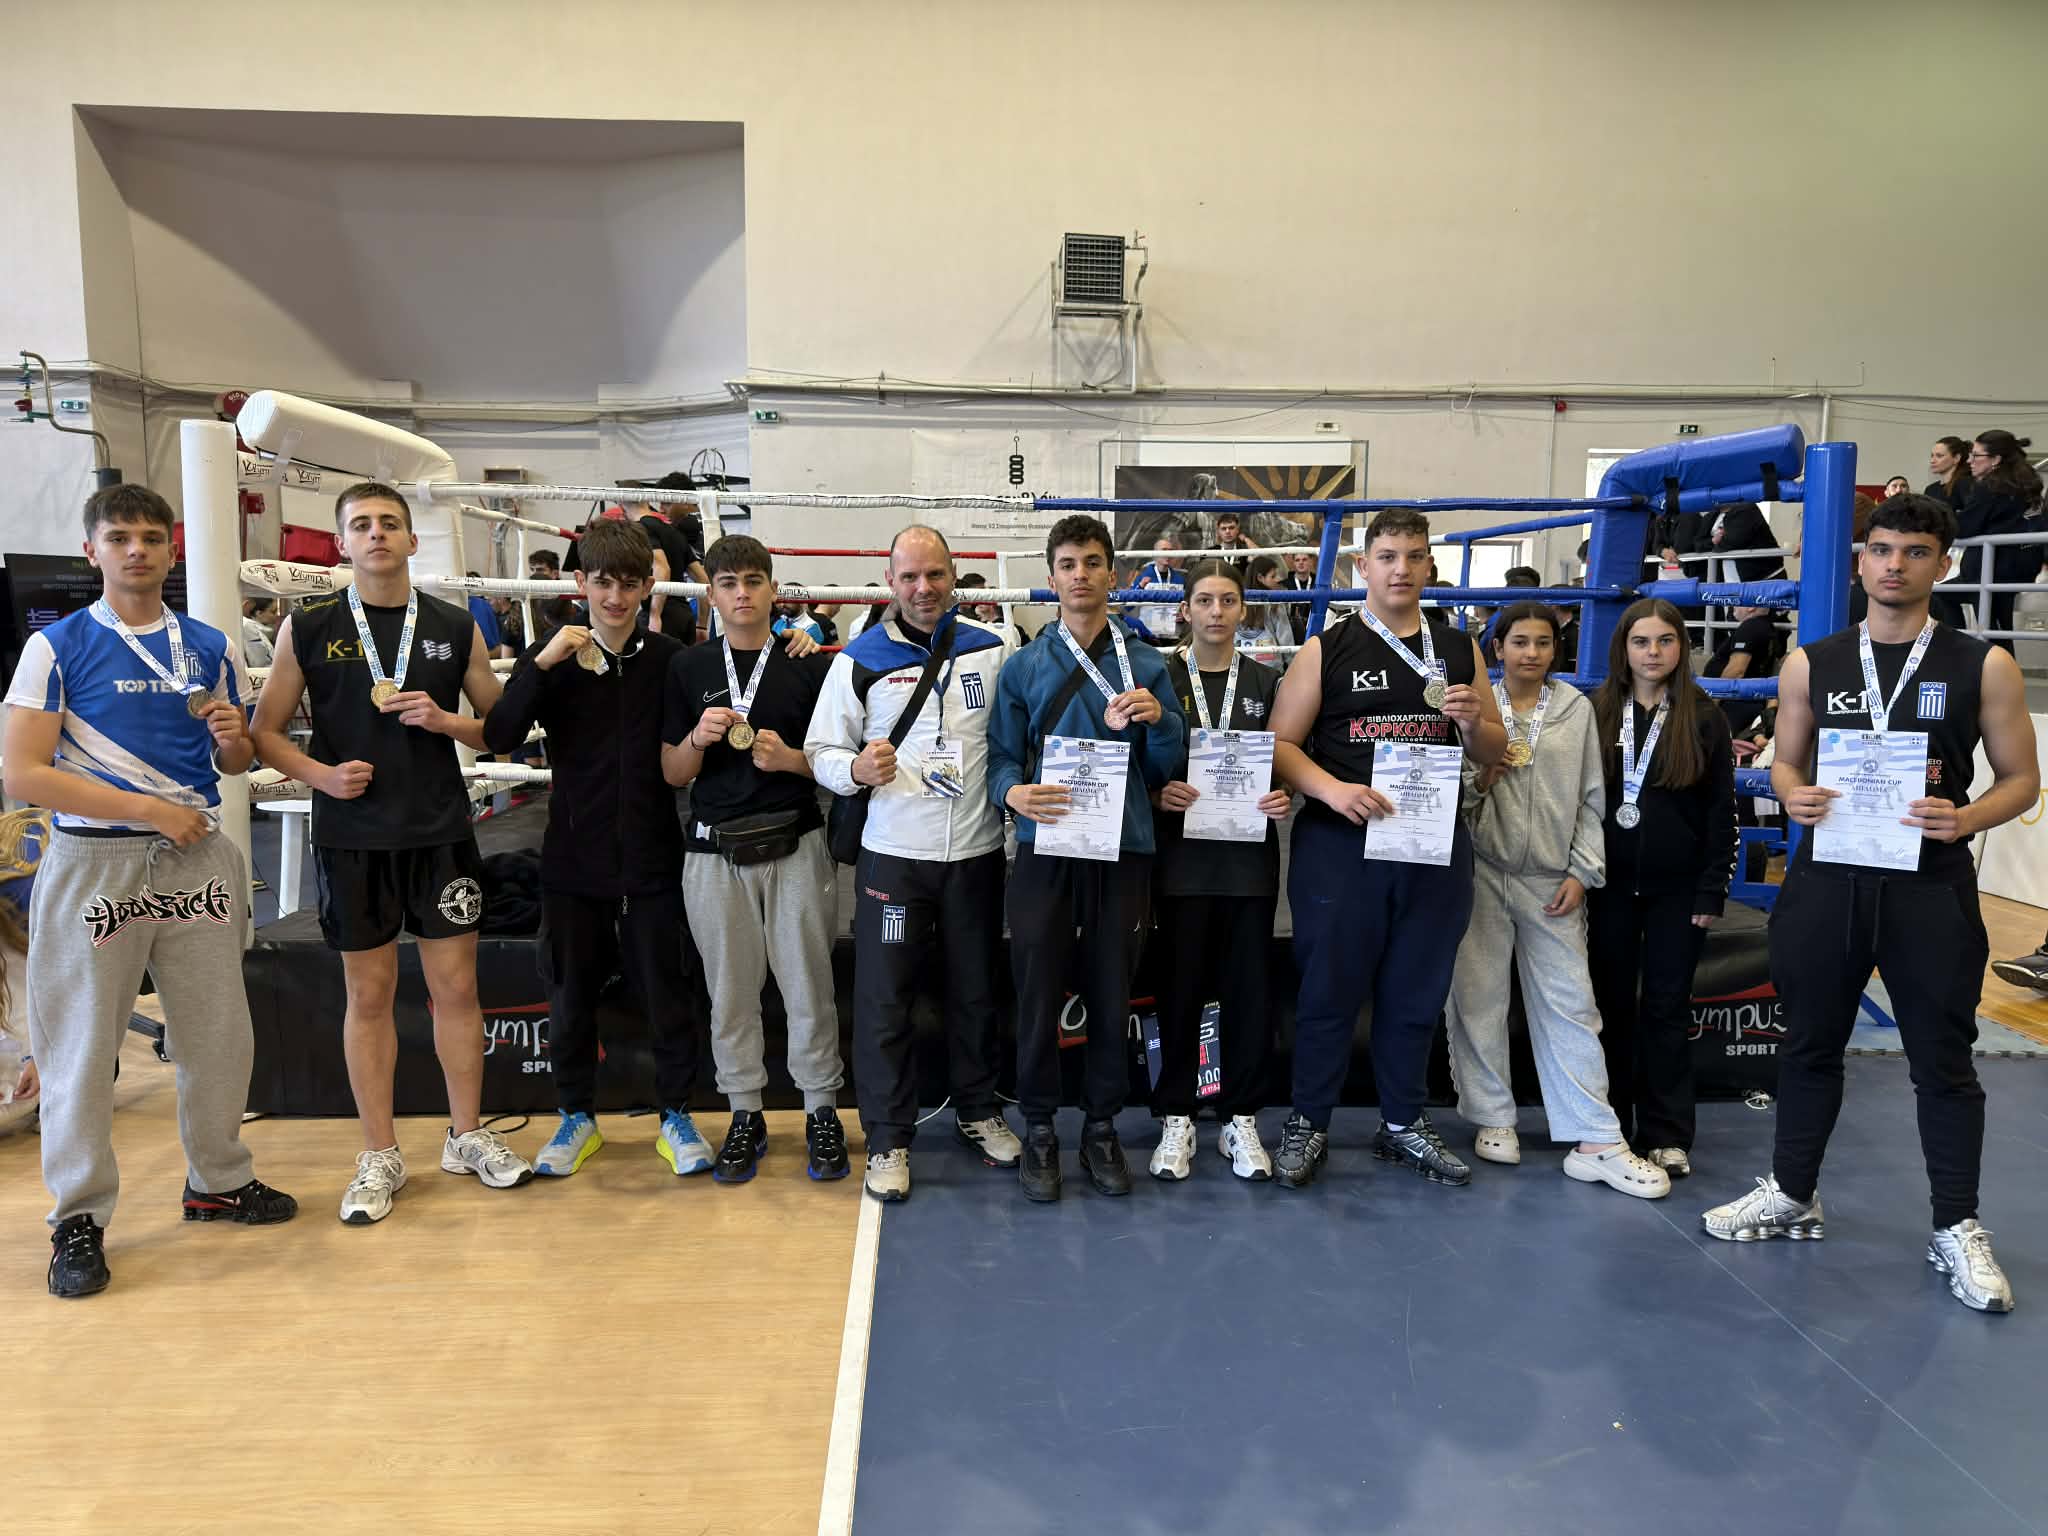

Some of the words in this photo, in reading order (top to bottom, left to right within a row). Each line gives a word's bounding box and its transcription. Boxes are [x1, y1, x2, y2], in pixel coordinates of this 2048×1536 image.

[327, 639, 364, 658] K-1
[1352, 669, 1389, 689] K-1
[113, 680, 146, 693] TOP
[149, 680, 175, 693] TE
[1828, 691, 1867, 711] K-1
[1058, 778, 1097, 787] MACEDONIAN
[1838, 776, 1886, 784] MACEDONIAN
[1389, 783, 1428, 791] MACEDONIAN
[1725, 1043, 1778, 1056] SPORT
